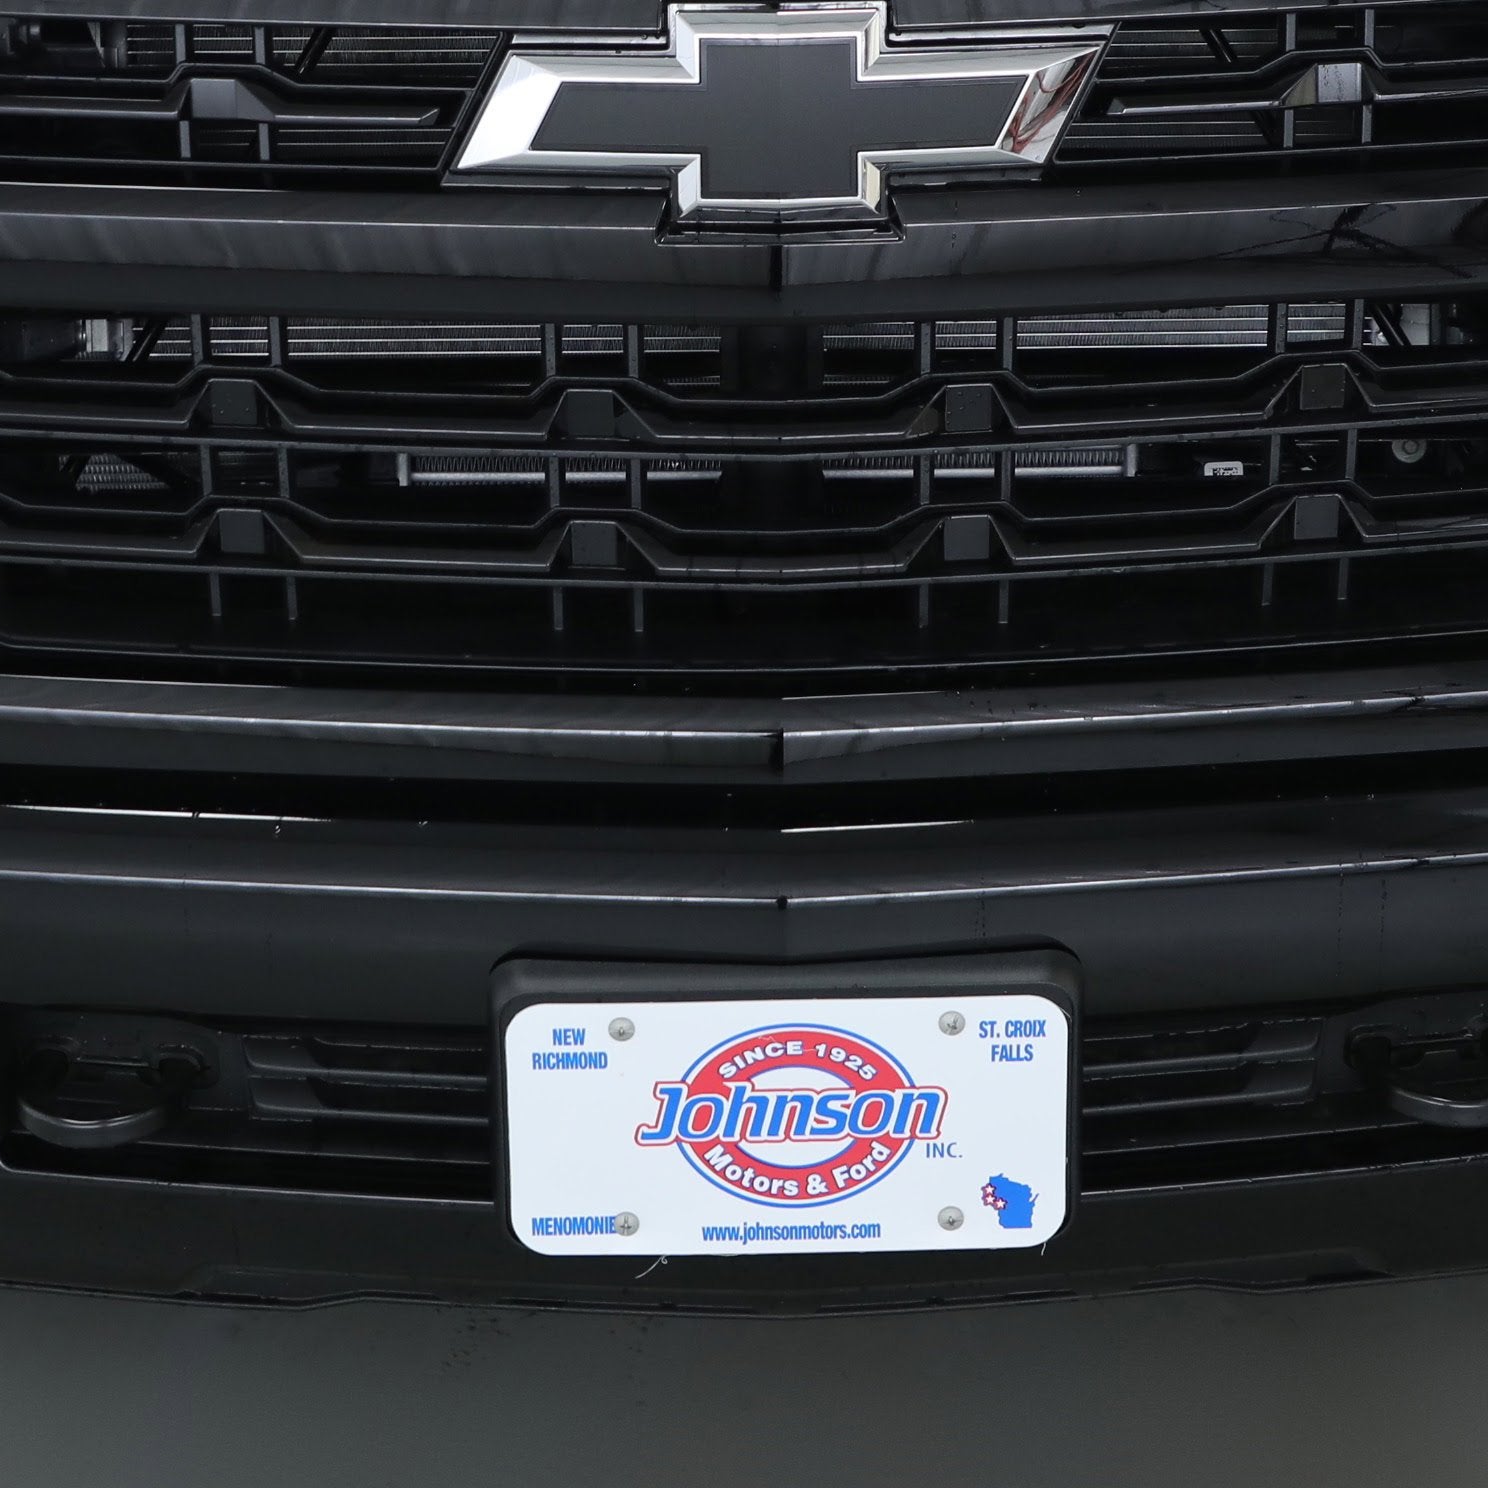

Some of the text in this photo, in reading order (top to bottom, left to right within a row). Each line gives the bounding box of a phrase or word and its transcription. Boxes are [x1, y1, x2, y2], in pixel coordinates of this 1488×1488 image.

[552, 1028, 586, 1046] NEW
[978, 1020, 1046, 1038] ST. CROIX
[532, 1051, 608, 1070] RICHMOND
[718, 1040, 878, 1081] SINCE 1925
[991, 1044, 1034, 1062] FALLS
[638, 1083, 943, 1143] Johnson
[925, 1142, 963, 1159] INC.
[703, 1140, 893, 1197] Motors & Ford
[532, 1216, 617, 1236] MENOMONIE
[702, 1221, 881, 1245] www.johnsonmotors.com
